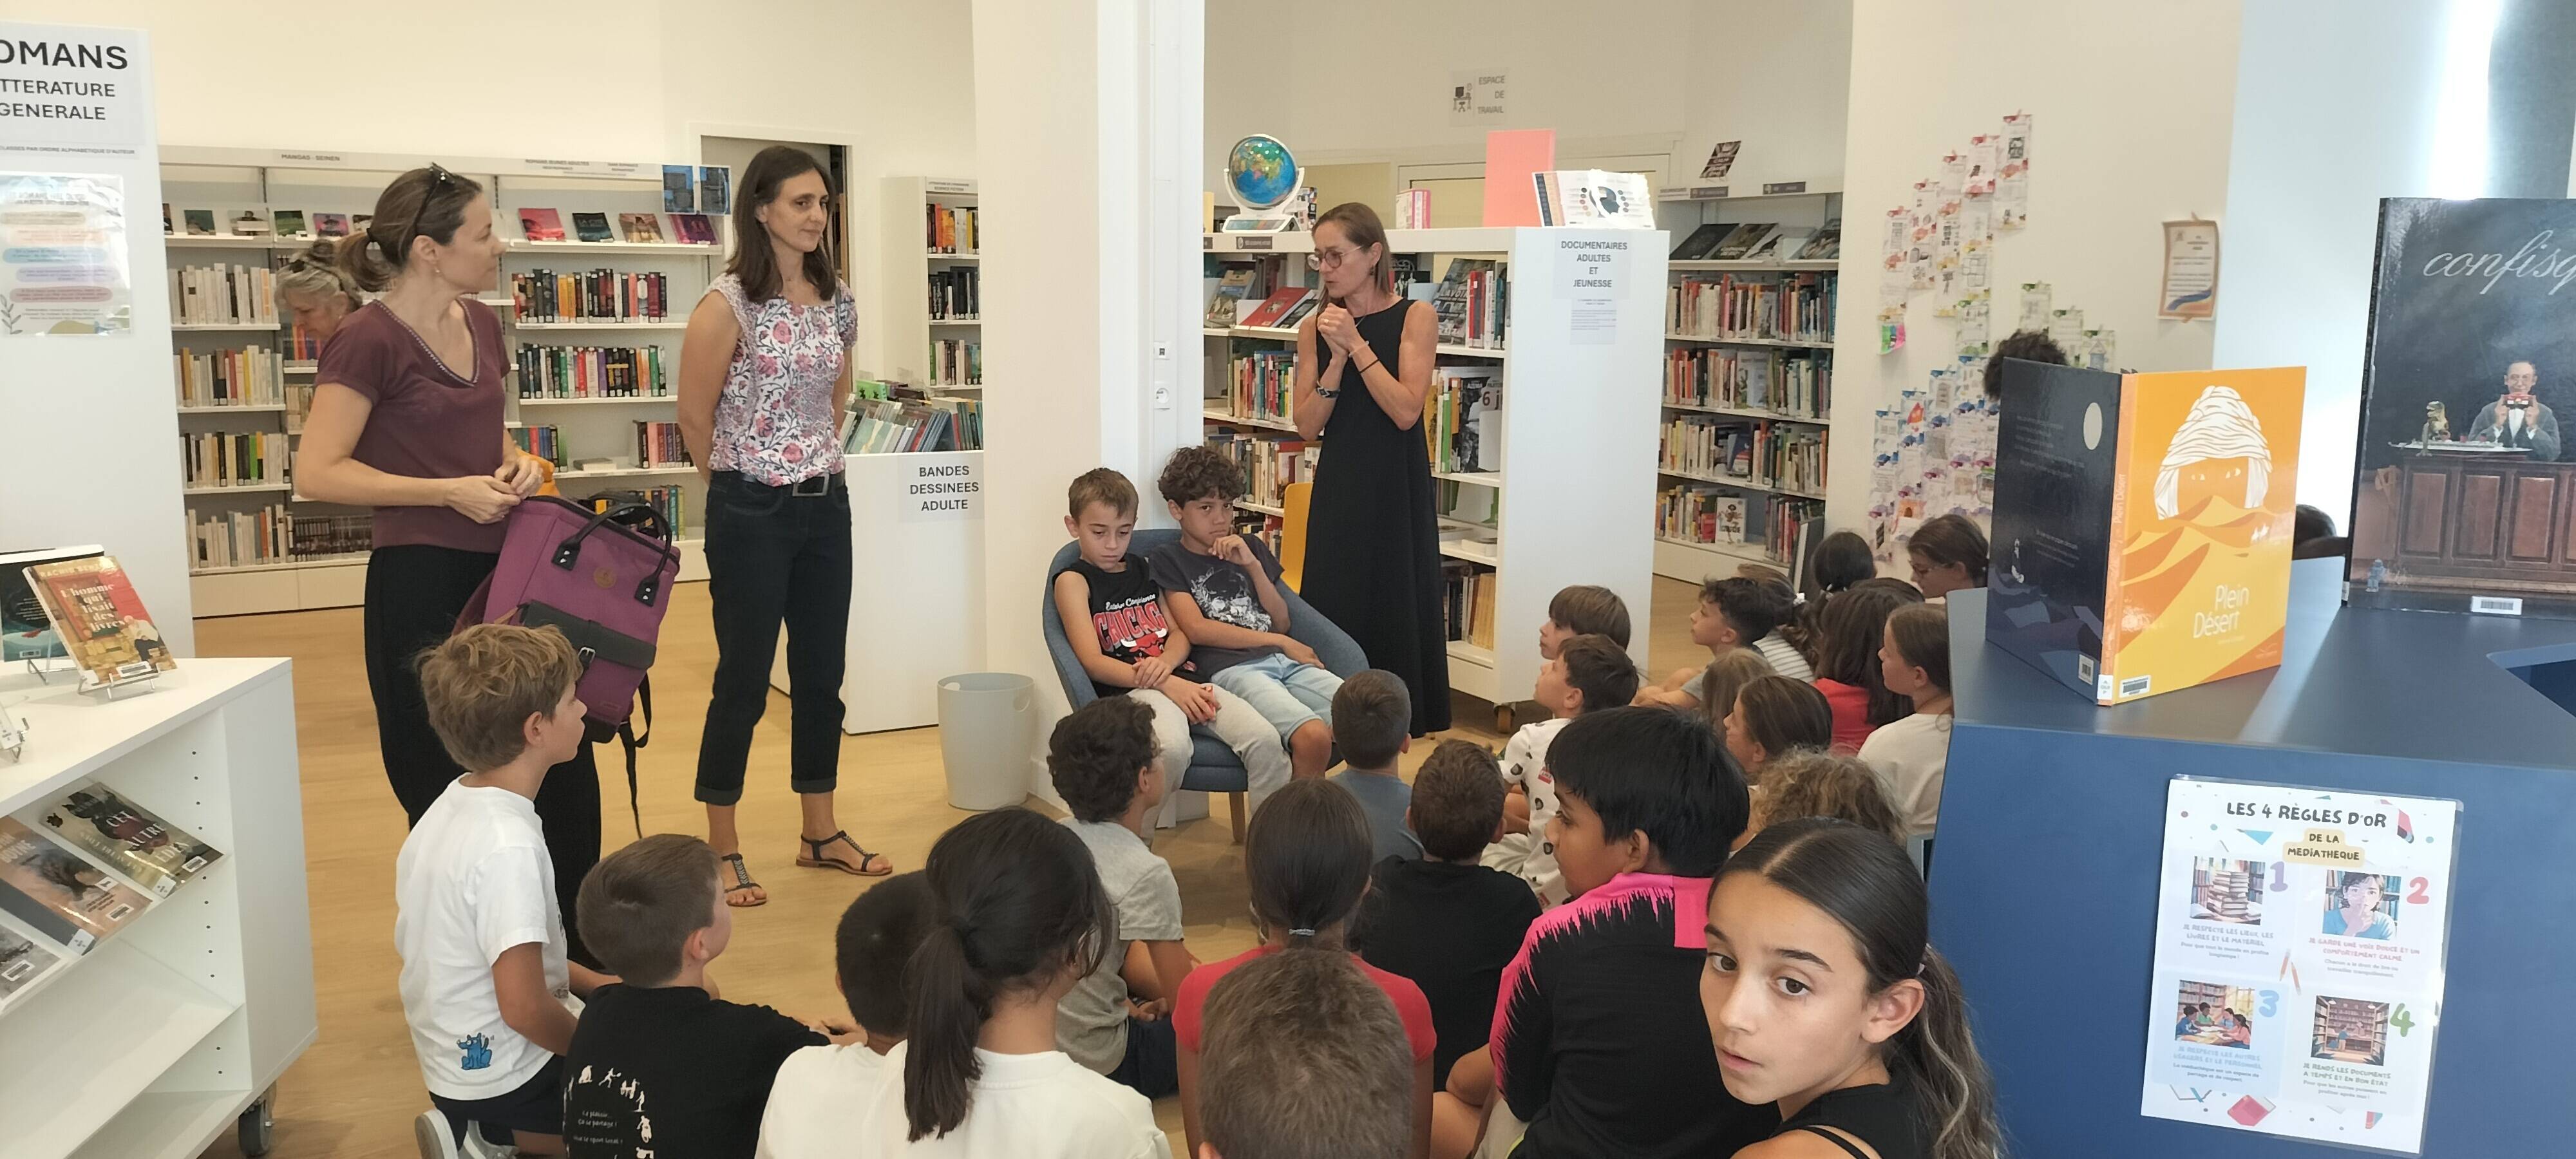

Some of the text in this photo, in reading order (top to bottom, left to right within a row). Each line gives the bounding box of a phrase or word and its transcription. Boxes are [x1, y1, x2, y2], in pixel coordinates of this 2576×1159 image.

[0, 39, 128, 70] OMANS
[1478, 75, 1505, 85] ESPACE
[0, 79, 115, 97] TTERATURE
[1494, 90, 1505, 99] DE
[0, 102, 106, 120] GENERALE
[1477, 106, 1504, 114] TRAVAIL
[1561, 241, 1627, 250] DOCUMENTAIRES
[2423, 230, 2576, 295] confisq
[1589, 267, 1598, 275] ET
[919, 466, 969, 477] BANDES
[910, 482, 979, 495] DESSINEES
[921, 500, 968, 511] ADULTE
[83, 592, 104, 605] qui
[2215, 584, 2249, 611] Plein
[80, 601, 115, 614] lisait
[93, 612, 115, 621] des
[90, 620, 126, 632] livres
[1093, 601, 1169, 652] CHICAG
[2193, 611, 2240, 639] Désert
[2227, 802, 2256, 816] LES
[2262, 804, 2272, 818] 4
[2278, 802, 2343, 824] RÈGLES
[2309, 833, 2339, 843] DE LA
[2269, 861, 2288, 892] 1
[2407, 876, 2430, 904] 2
[2192, 925, 2224, 934] RESPECTE
[2323, 948, 2378, 958] COMPORTEMENT
[2259, 990, 2280, 1017] 3
[2390, 1003, 2416, 1037] 4
